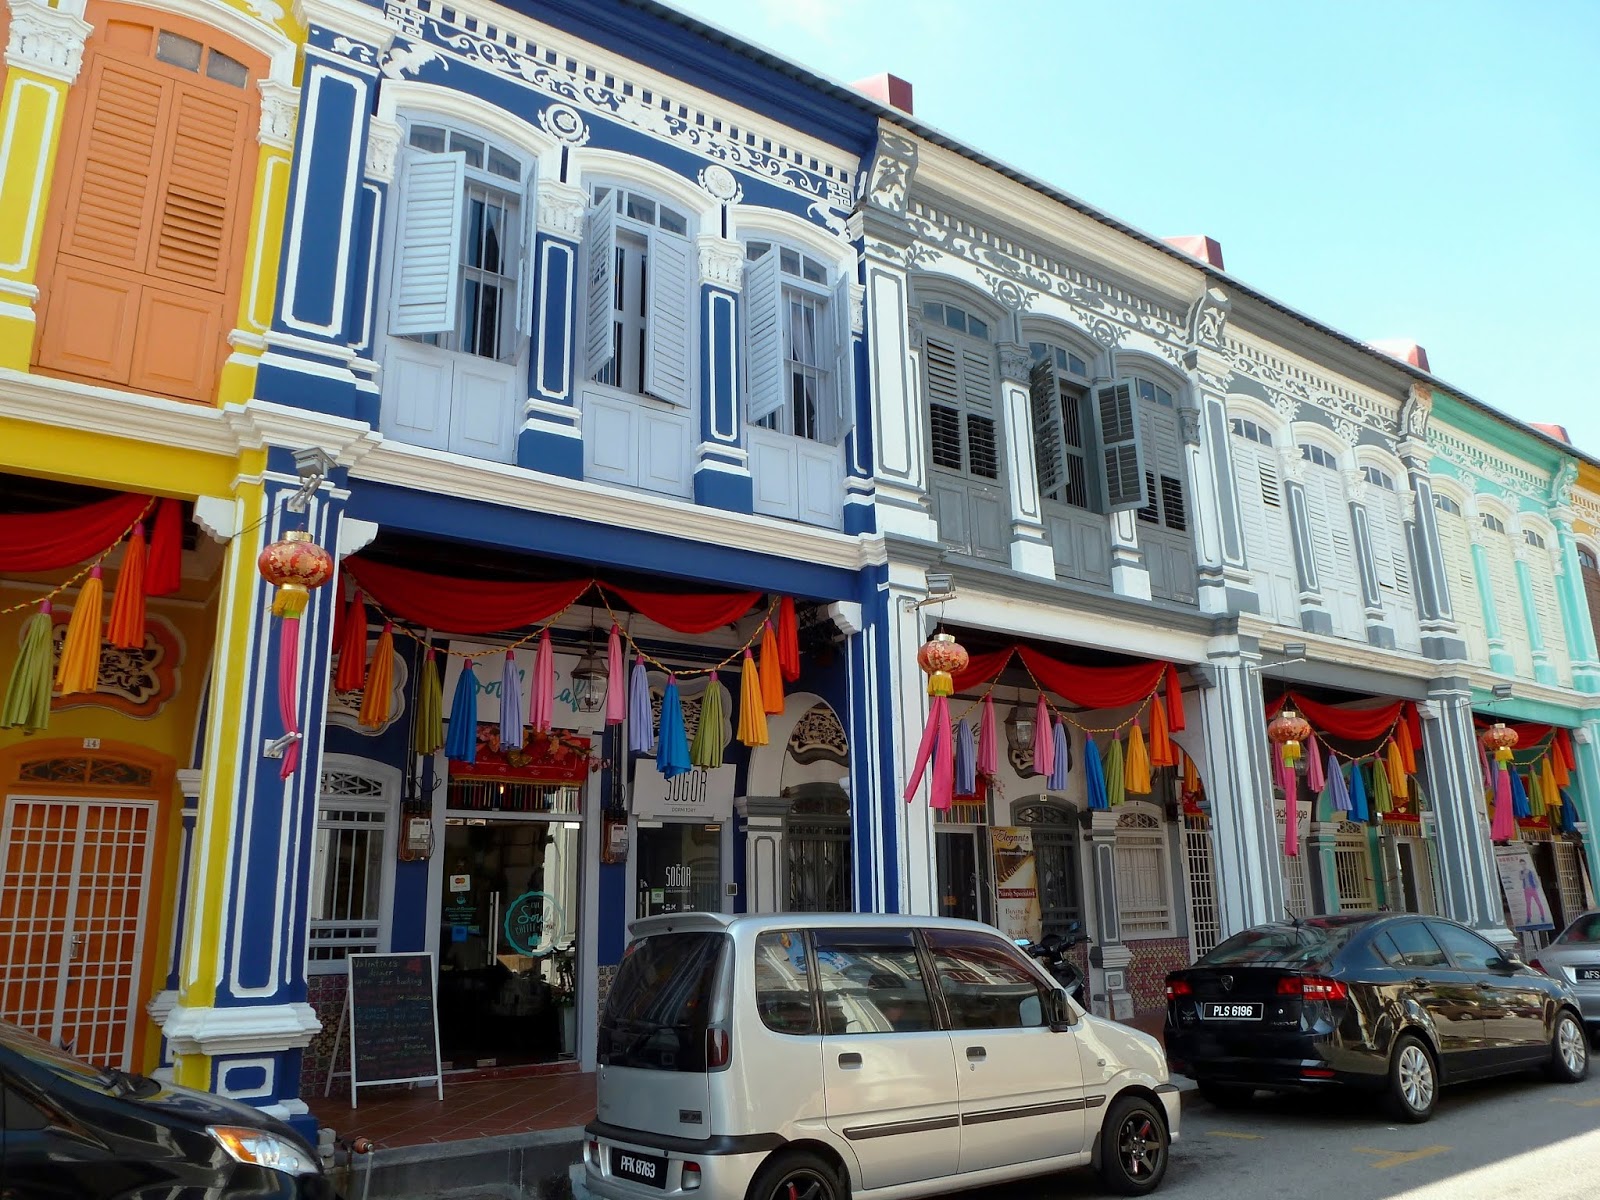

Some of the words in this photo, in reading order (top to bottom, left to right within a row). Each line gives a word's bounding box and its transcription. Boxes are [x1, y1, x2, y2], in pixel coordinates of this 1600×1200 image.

[665, 866, 691, 888] SOGOR
[1584, 970, 1600, 979] AFS
[1213, 1005, 1230, 1017] PLS
[1231, 1005, 1253, 1017] 6196
[620, 1155, 636, 1173] PFK
[635, 1159, 656, 1178] 8763
